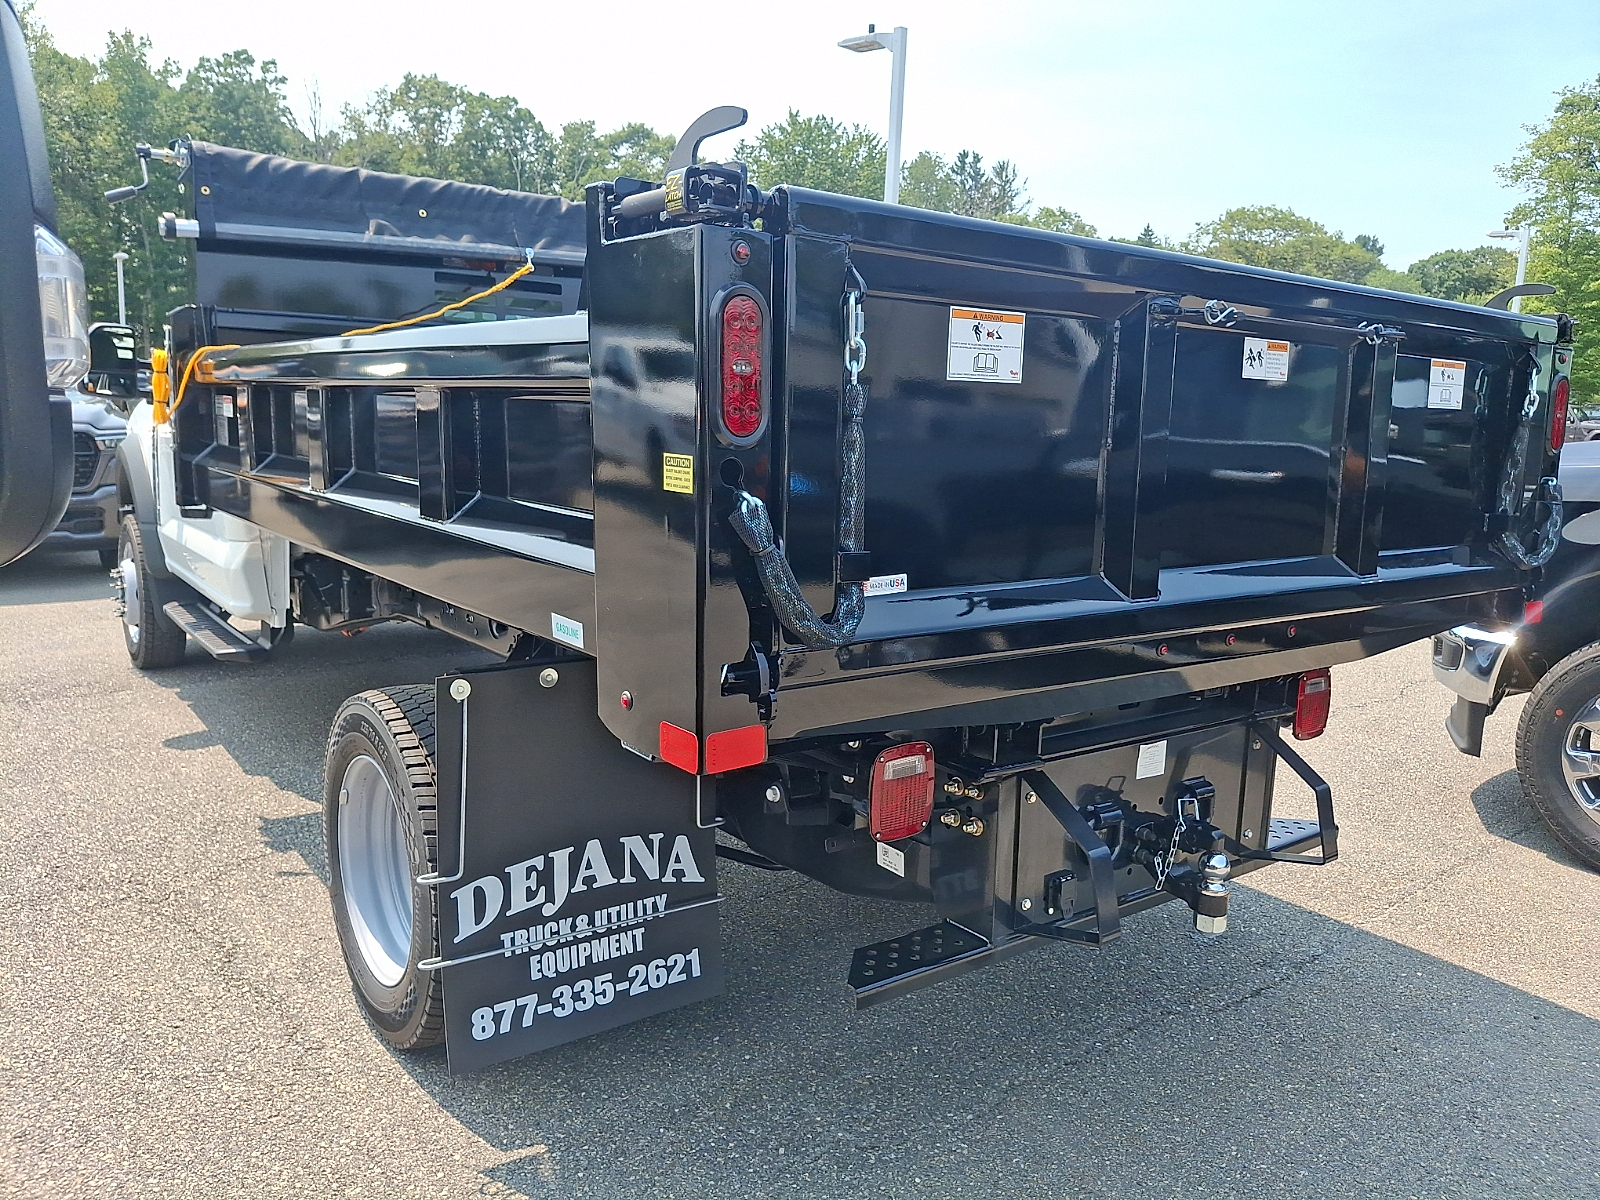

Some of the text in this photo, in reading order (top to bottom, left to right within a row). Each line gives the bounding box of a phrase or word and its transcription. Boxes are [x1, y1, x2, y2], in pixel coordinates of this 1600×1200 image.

[665, 190, 682, 203] LATCH
[979, 312, 1004, 322] WARNING
[666, 456, 691, 468] CAUTION
[889, 577, 906, 588] USA
[555, 621, 580, 640] GASOLINE
[450, 833, 705, 944] DEJANA
[529, 927, 646, 982] EQUIPMENT
[471, 948, 702, 1041] 877-335-2621
